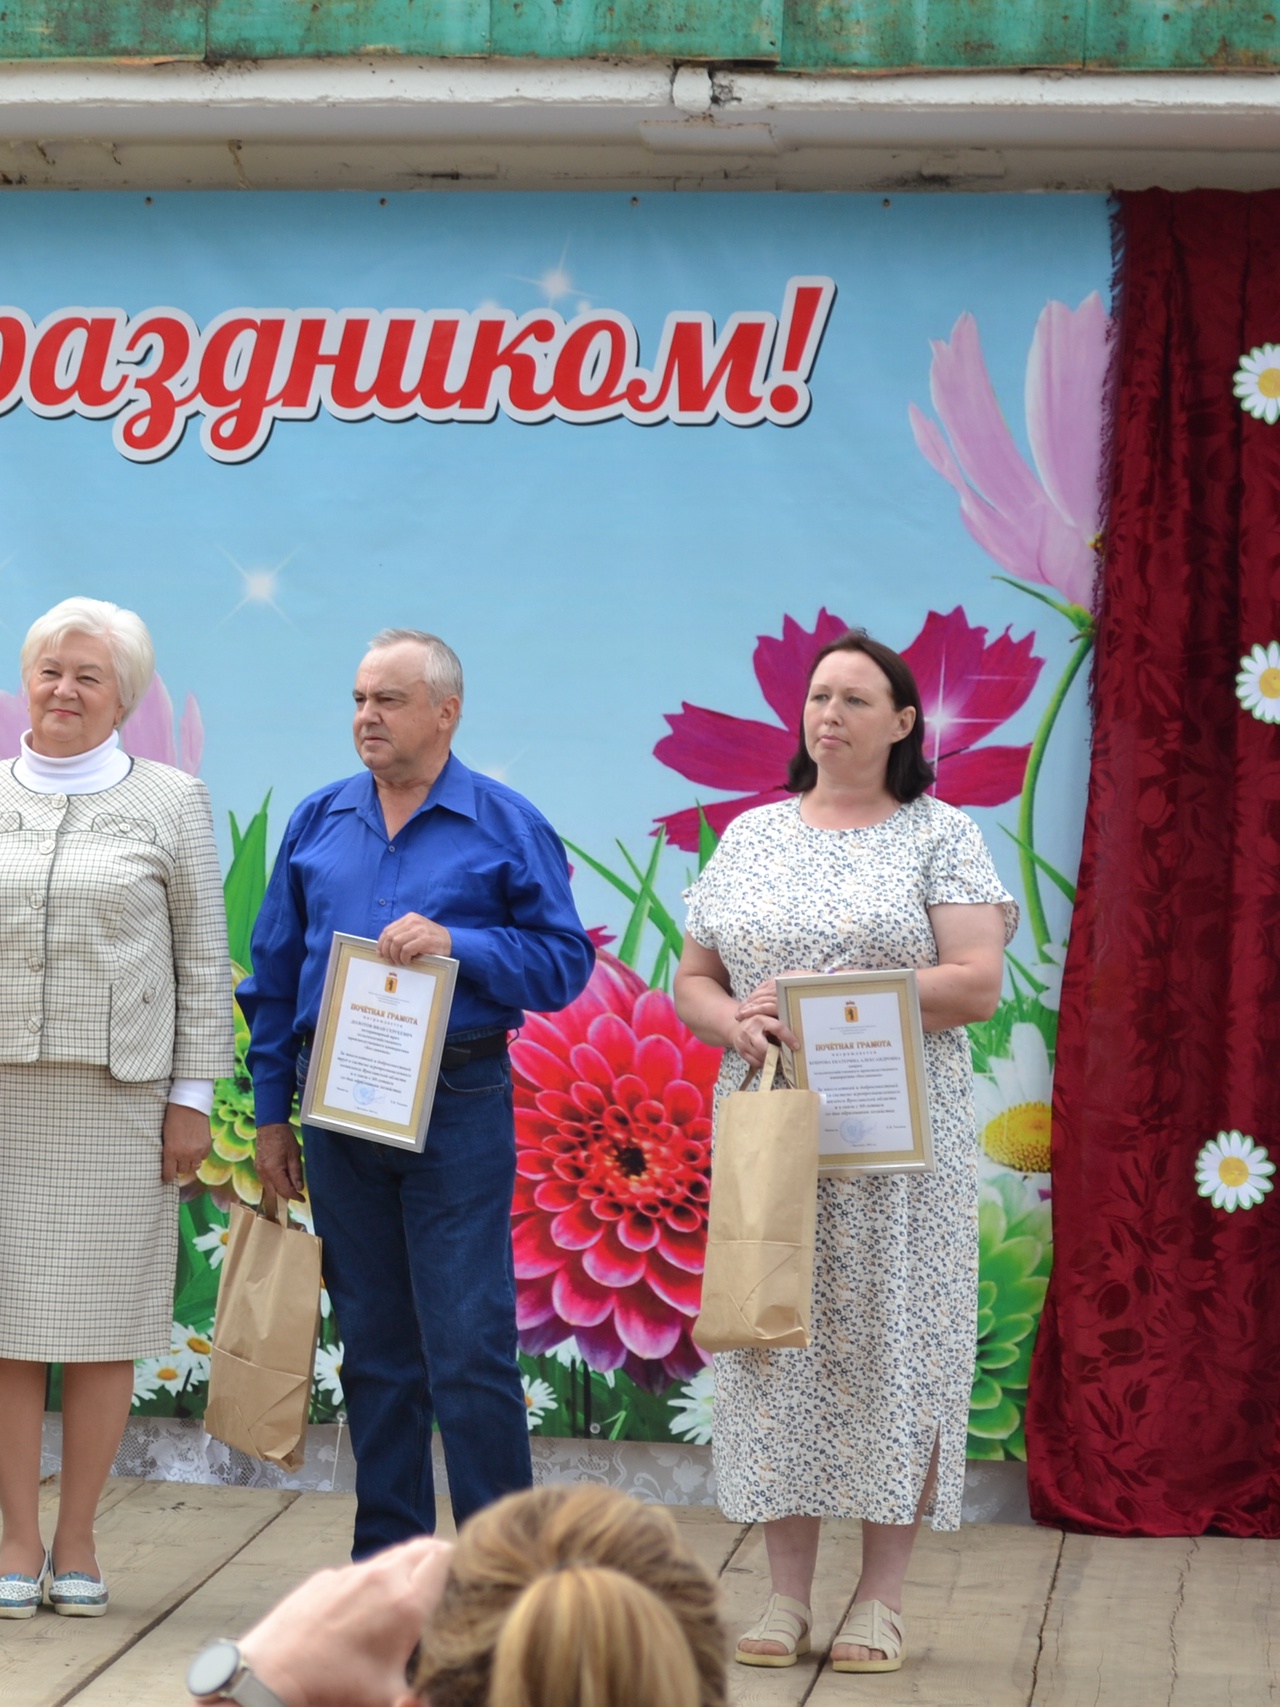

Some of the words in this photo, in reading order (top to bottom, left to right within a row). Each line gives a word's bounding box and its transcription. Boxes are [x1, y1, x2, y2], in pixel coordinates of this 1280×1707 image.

[387, 1012, 419, 1026] ГРАМОТА
[815, 1041, 854, 1052] ПОЧЁТНАЯ
[857, 1039, 892, 1049] ГРАМОТА
